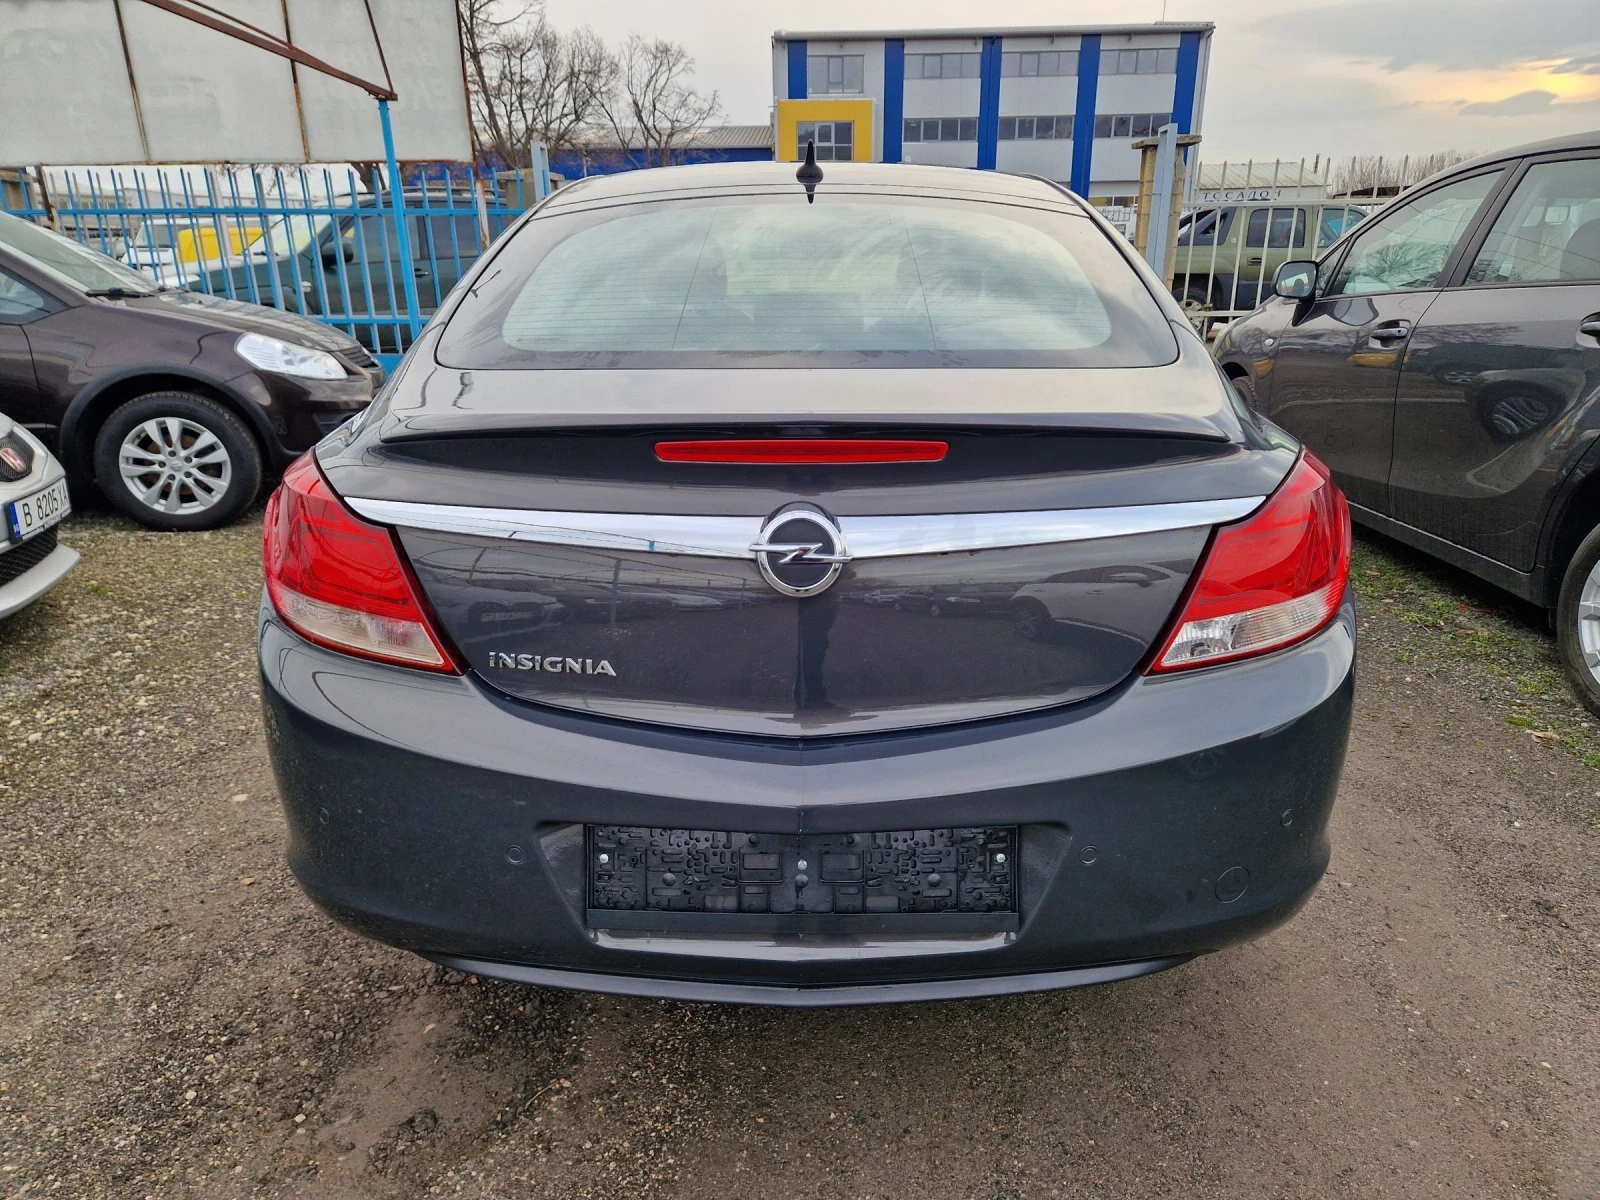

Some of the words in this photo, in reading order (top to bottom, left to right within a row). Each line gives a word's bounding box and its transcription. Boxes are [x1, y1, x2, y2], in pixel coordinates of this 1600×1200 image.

[22, 502, 33, 527] B
[36, 488, 59, 521] 8205
[489, 651, 617, 677] INSIGNIA
